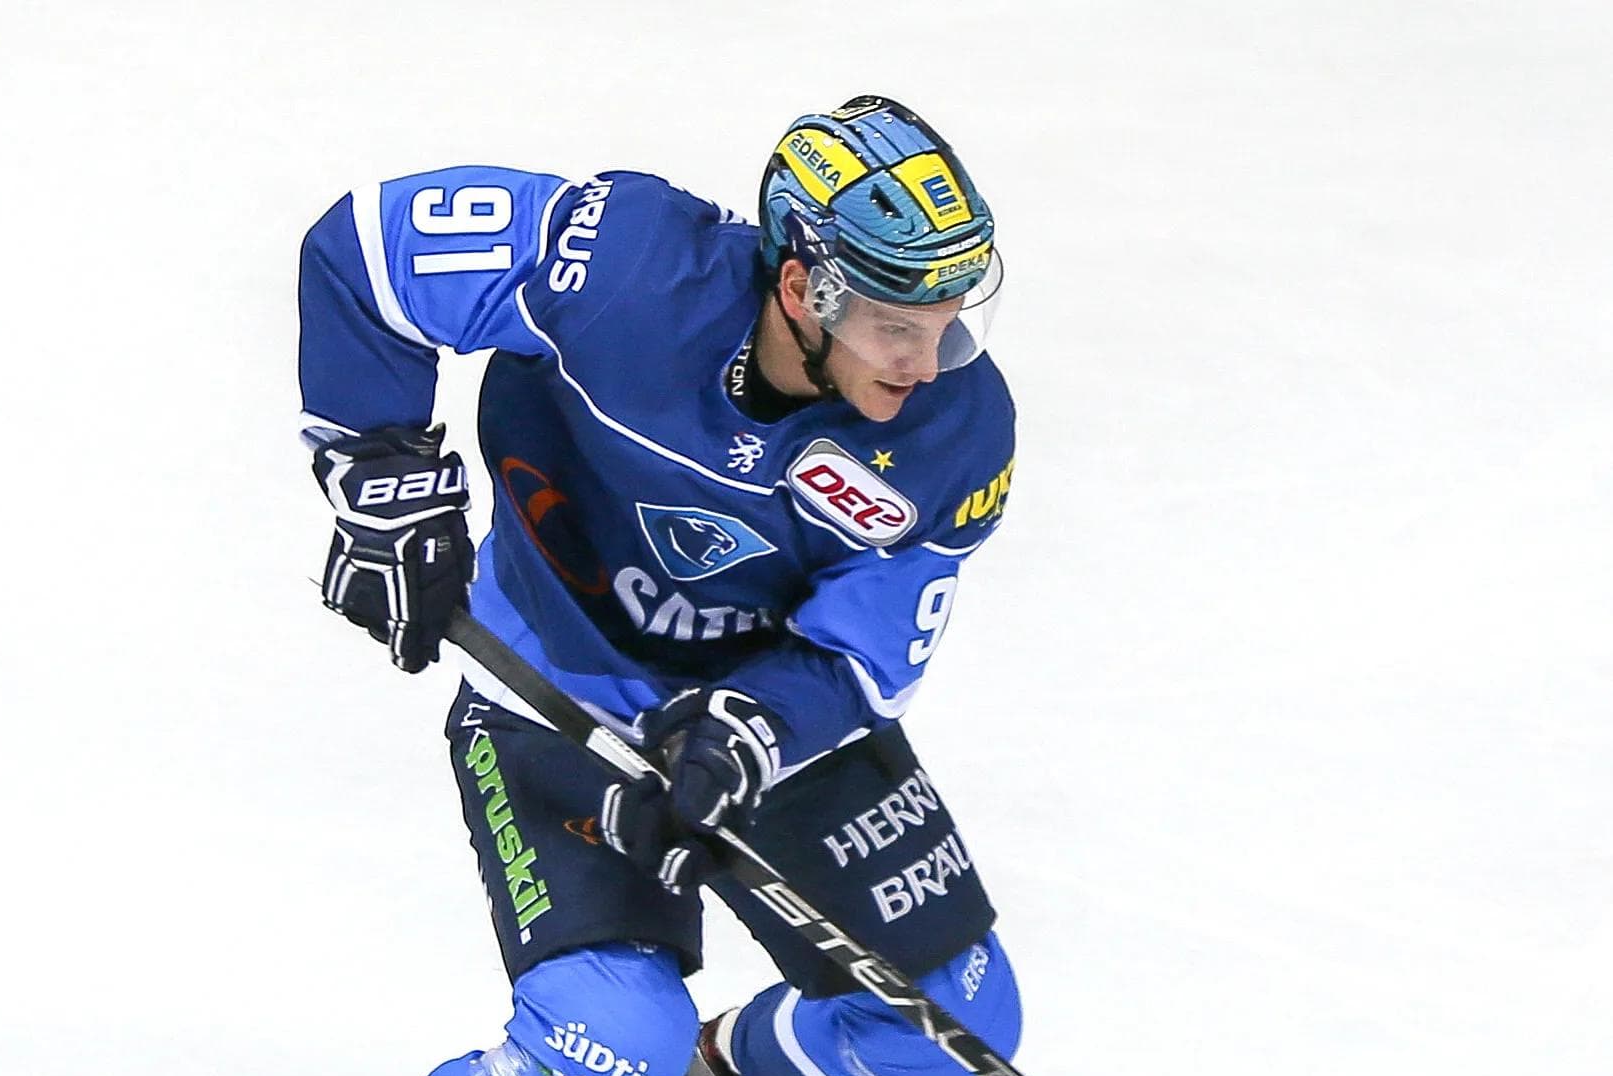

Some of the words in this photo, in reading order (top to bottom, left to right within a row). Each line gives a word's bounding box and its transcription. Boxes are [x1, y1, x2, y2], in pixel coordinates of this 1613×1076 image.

[788, 132, 844, 188] EDEKA
[411, 183, 514, 275] 91
[937, 253, 985, 280] EDEKA
